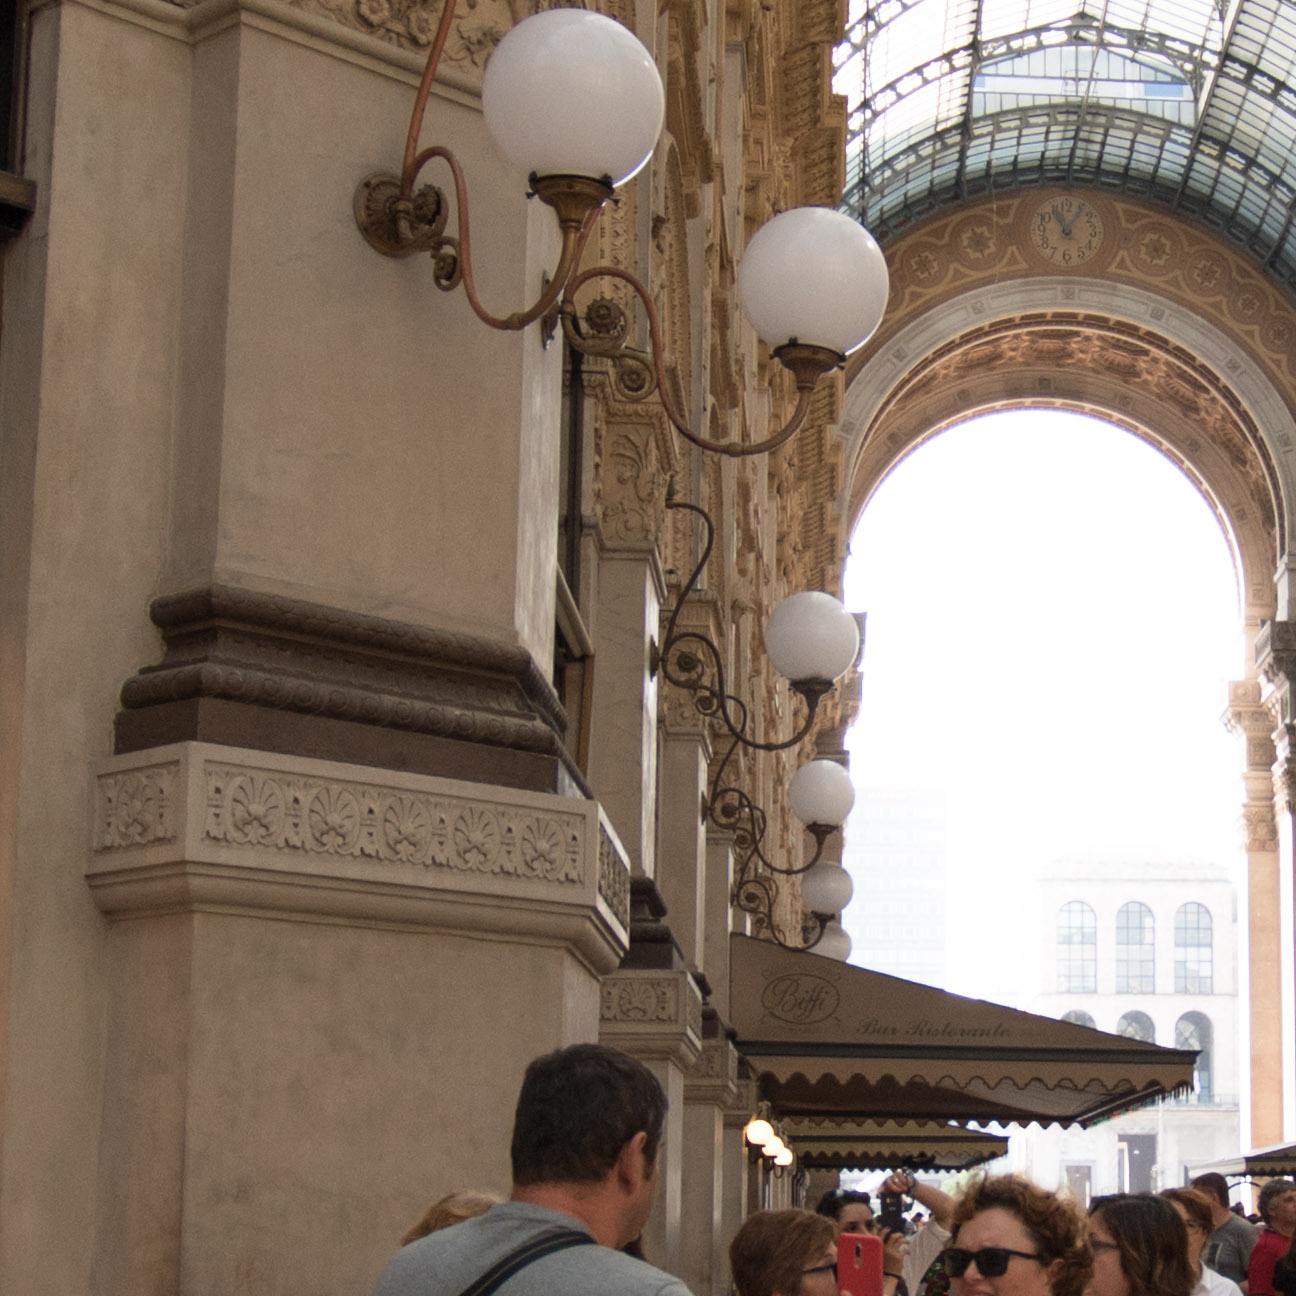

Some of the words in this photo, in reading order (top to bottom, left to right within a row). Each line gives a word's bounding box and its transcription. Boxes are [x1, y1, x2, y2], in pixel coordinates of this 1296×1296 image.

[1061, 198, 1073, 213] 12
[1063, 249, 1072, 262] 6
[856, 1019, 897, 1036] Bar
